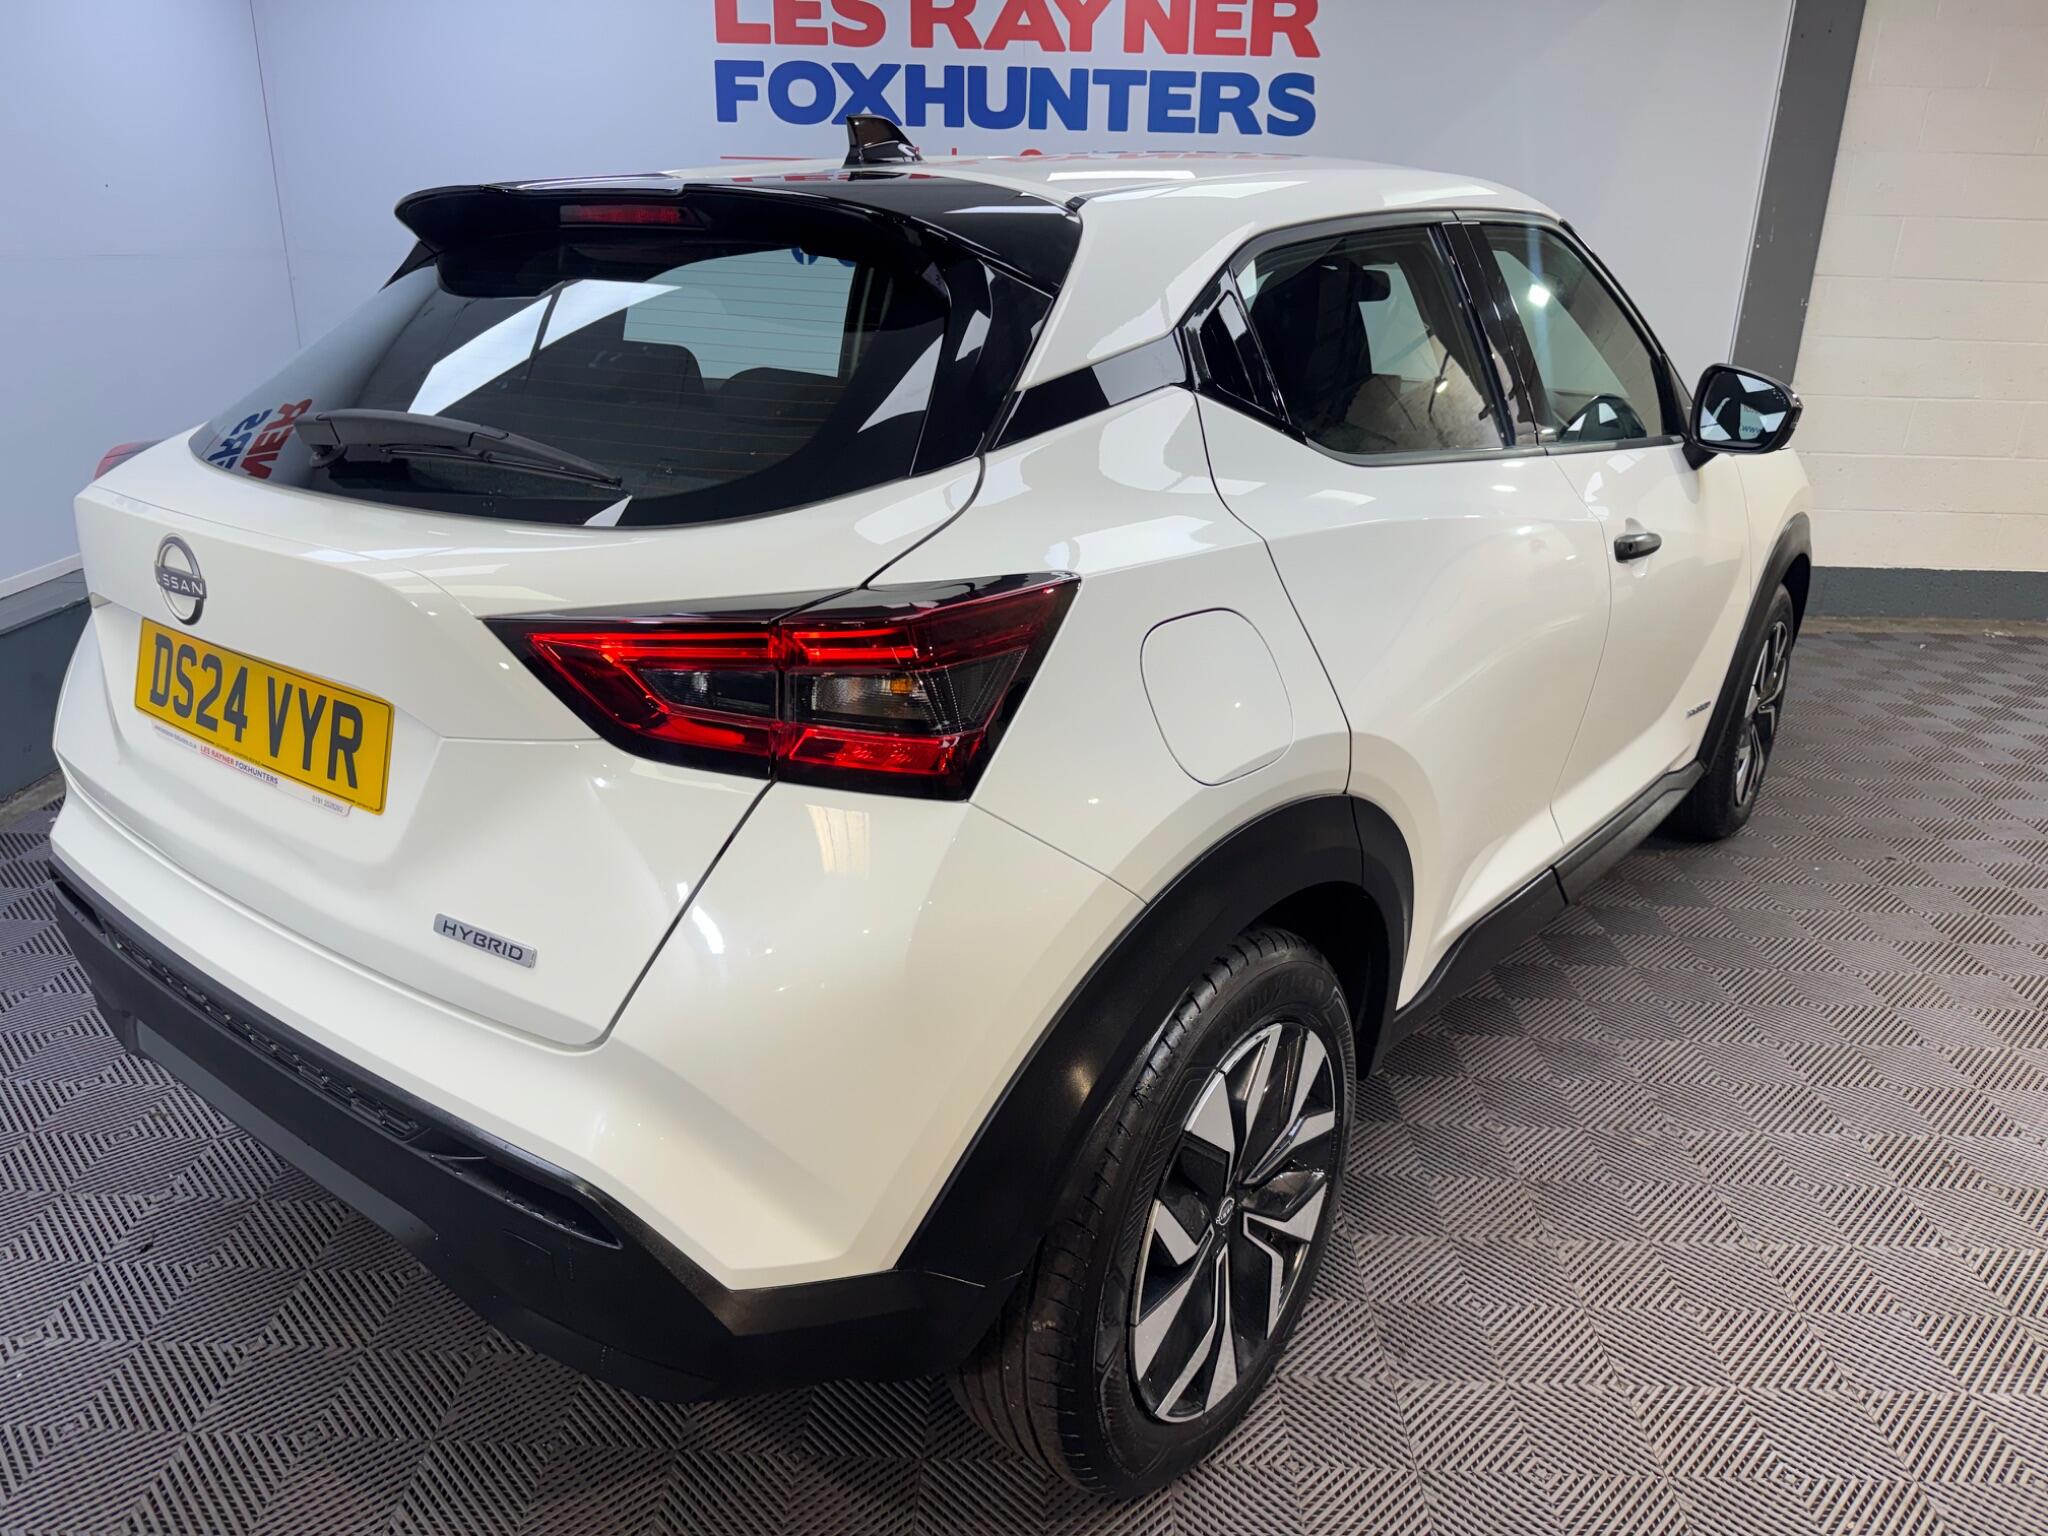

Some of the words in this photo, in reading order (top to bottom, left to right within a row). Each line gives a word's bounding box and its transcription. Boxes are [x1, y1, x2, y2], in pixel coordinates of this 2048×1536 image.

[717, 0, 887, 48] LES
[911, 0, 1321, 57] RAYNER
[714, 59, 1317, 137] FOXHUNTERS
[149, 632, 249, 743] DS24
[267, 675, 364, 790] VYR
[235, 761, 278, 784] FOXHUNTERS
[442, 919, 523, 961] HYBRID
